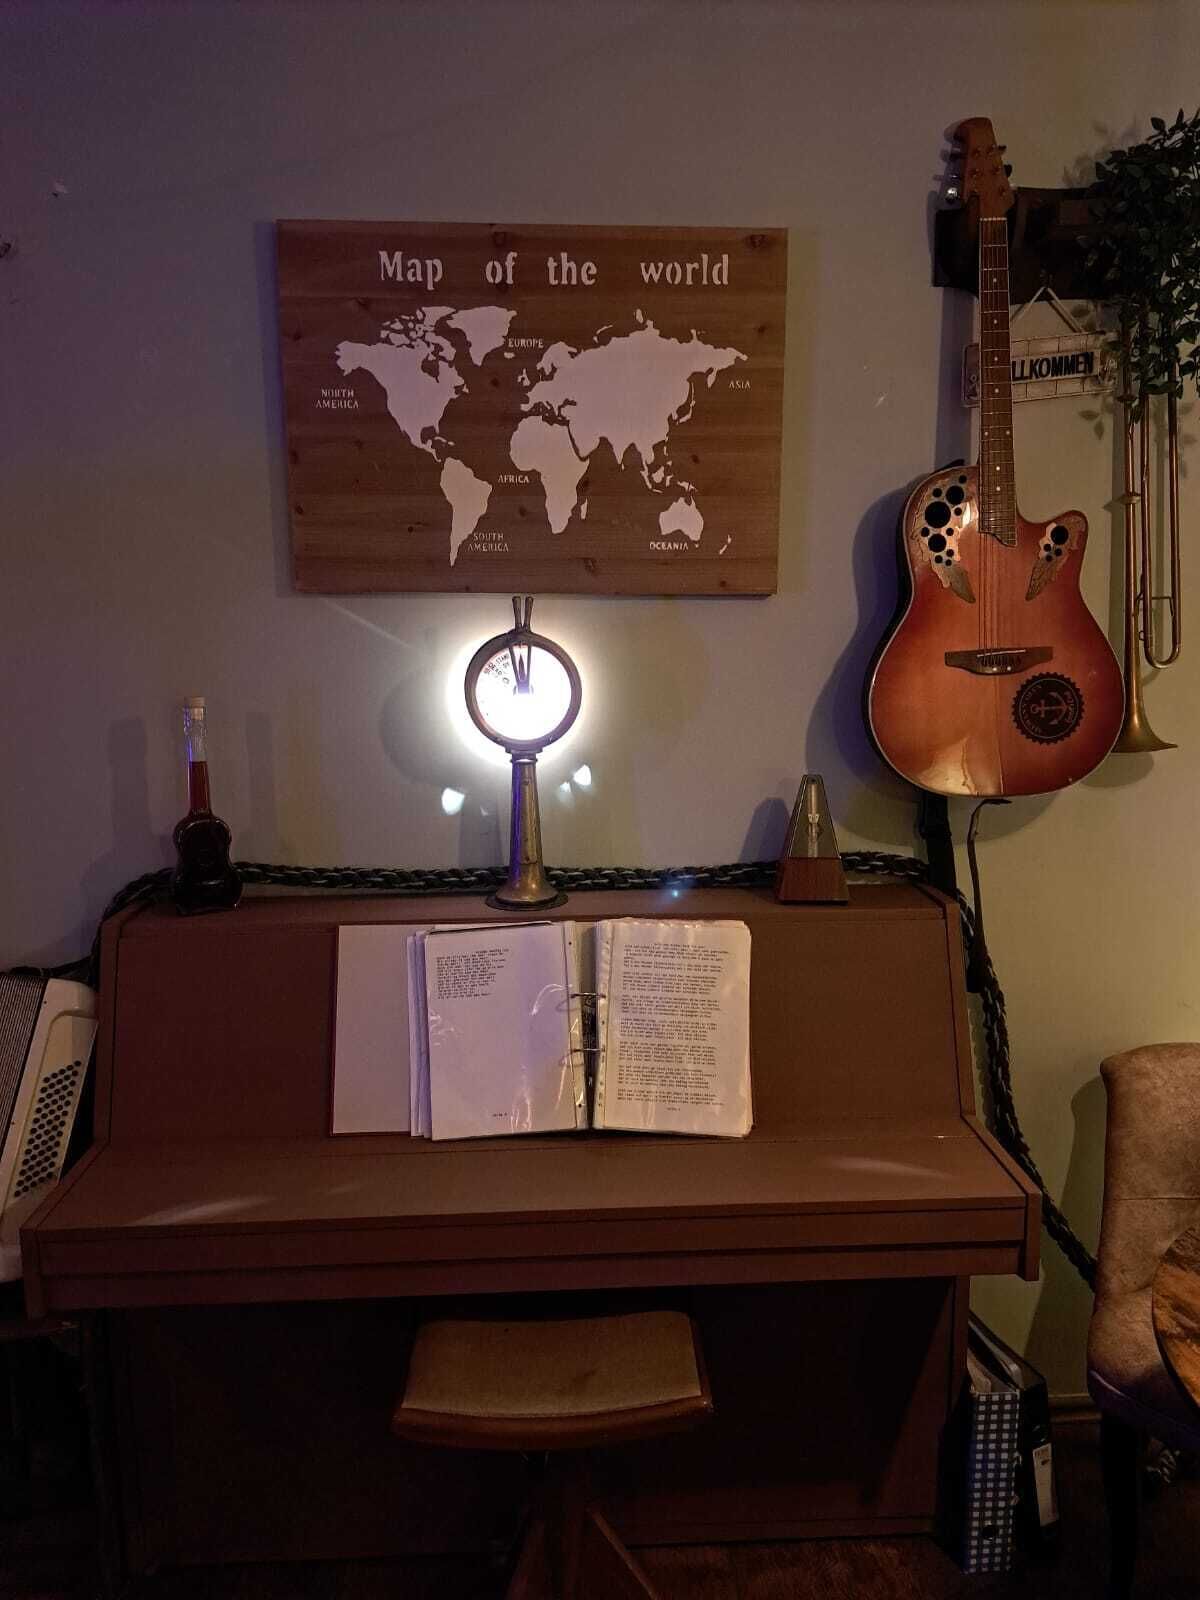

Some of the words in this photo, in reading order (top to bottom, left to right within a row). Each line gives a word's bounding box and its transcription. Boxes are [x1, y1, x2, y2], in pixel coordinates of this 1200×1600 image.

[378, 250, 443, 290] Map
[486, 251, 518, 285] of
[547, 252, 597, 286] the
[641, 253, 730, 285] world
[508, 338, 544, 349] EUROPE
[1012, 351, 1094, 379] LLKOMMEN
[729, 380, 751, 389] ASIA
[321, 389, 354, 398] NORTH
[315, 399, 359, 409] AMERICA
[498, 474, 530, 484] AFRICA
[473, 532, 504, 542] SOUTH
[468, 542, 509, 552] AMERICA
[649, 541, 689, 551] OCEANIA
